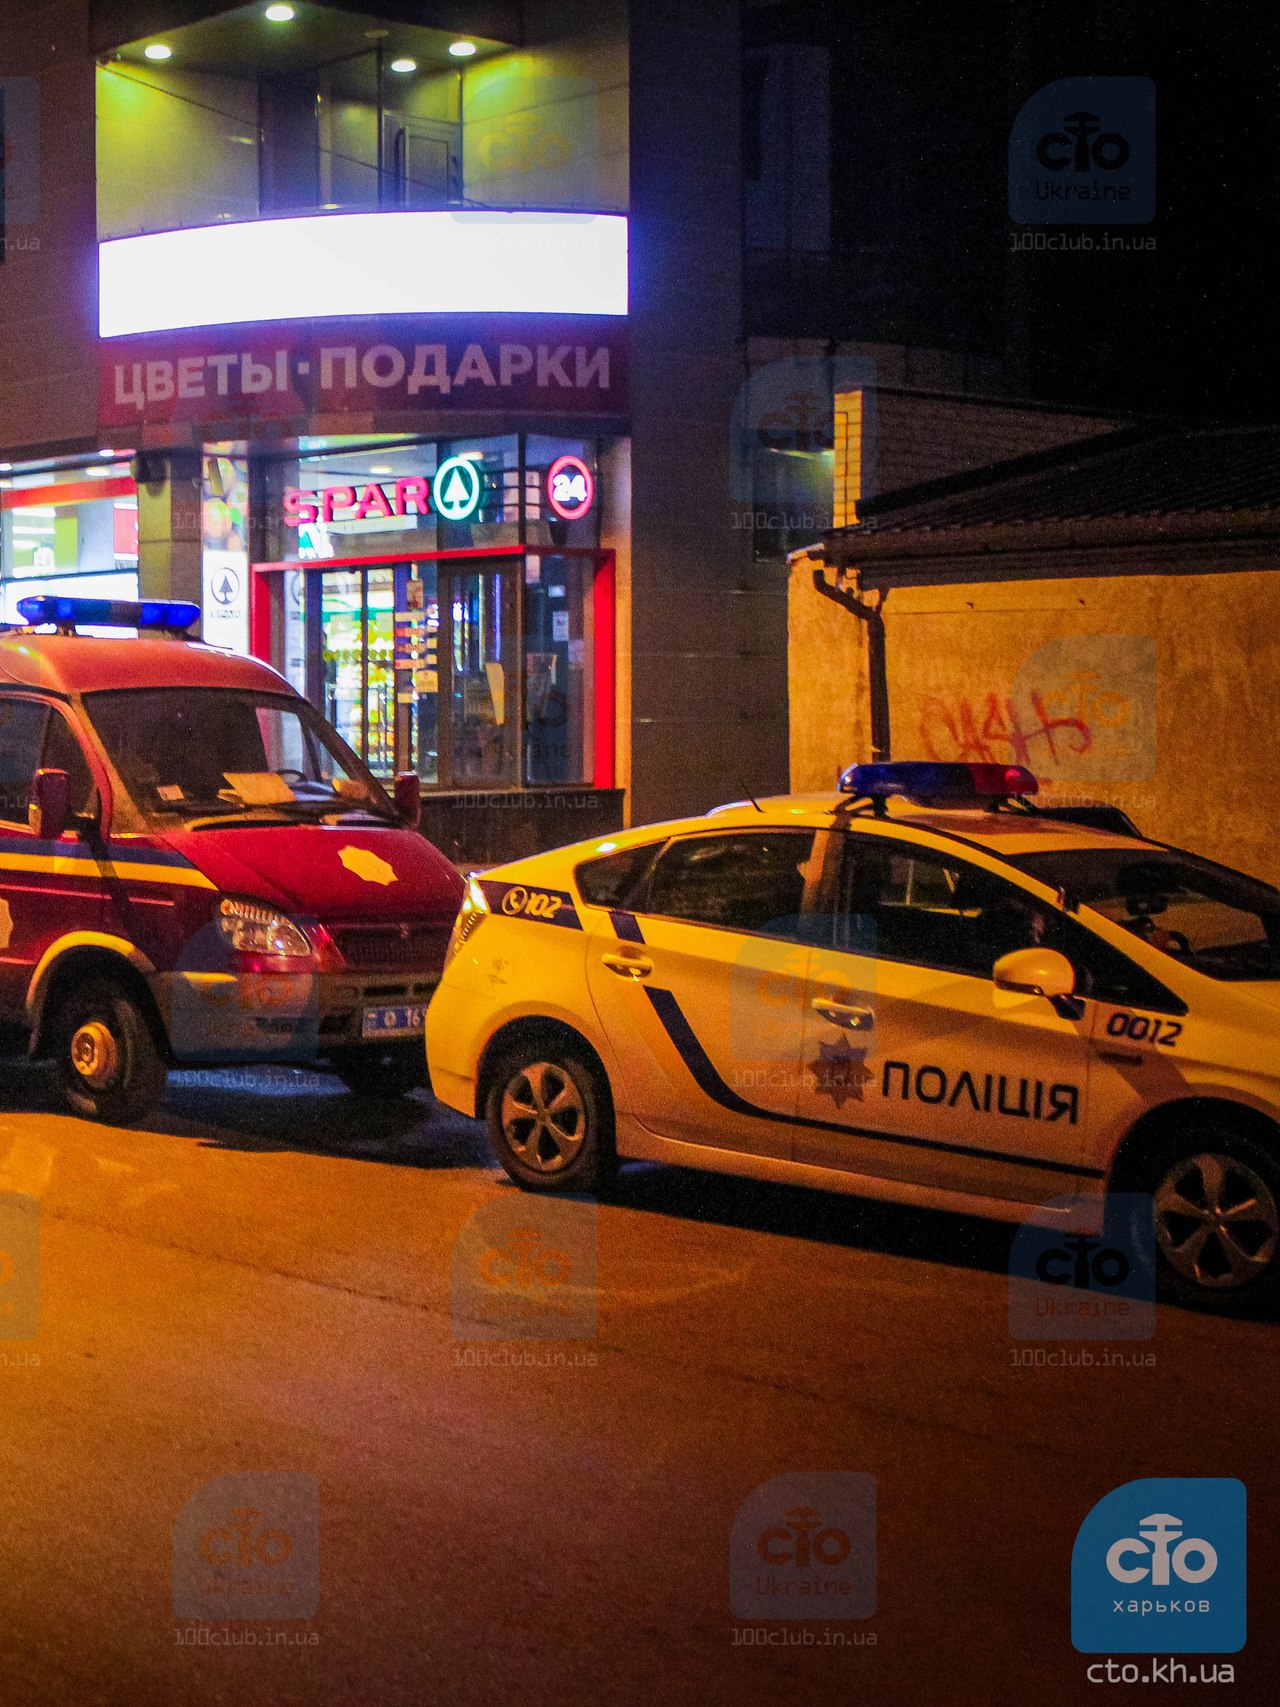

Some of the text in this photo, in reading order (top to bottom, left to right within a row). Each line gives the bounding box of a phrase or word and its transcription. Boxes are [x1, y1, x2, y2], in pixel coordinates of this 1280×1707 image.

[320, 344, 610, 395] ПОДАРКИ
[284, 476, 430, 527] SPAR
[552, 474, 588, 502] 24
[524, 892, 562, 919] 102
[1107, 1012, 1182, 1047] 0012
[882, 1060, 1079, 1125] ПОЛІЦІЯ
